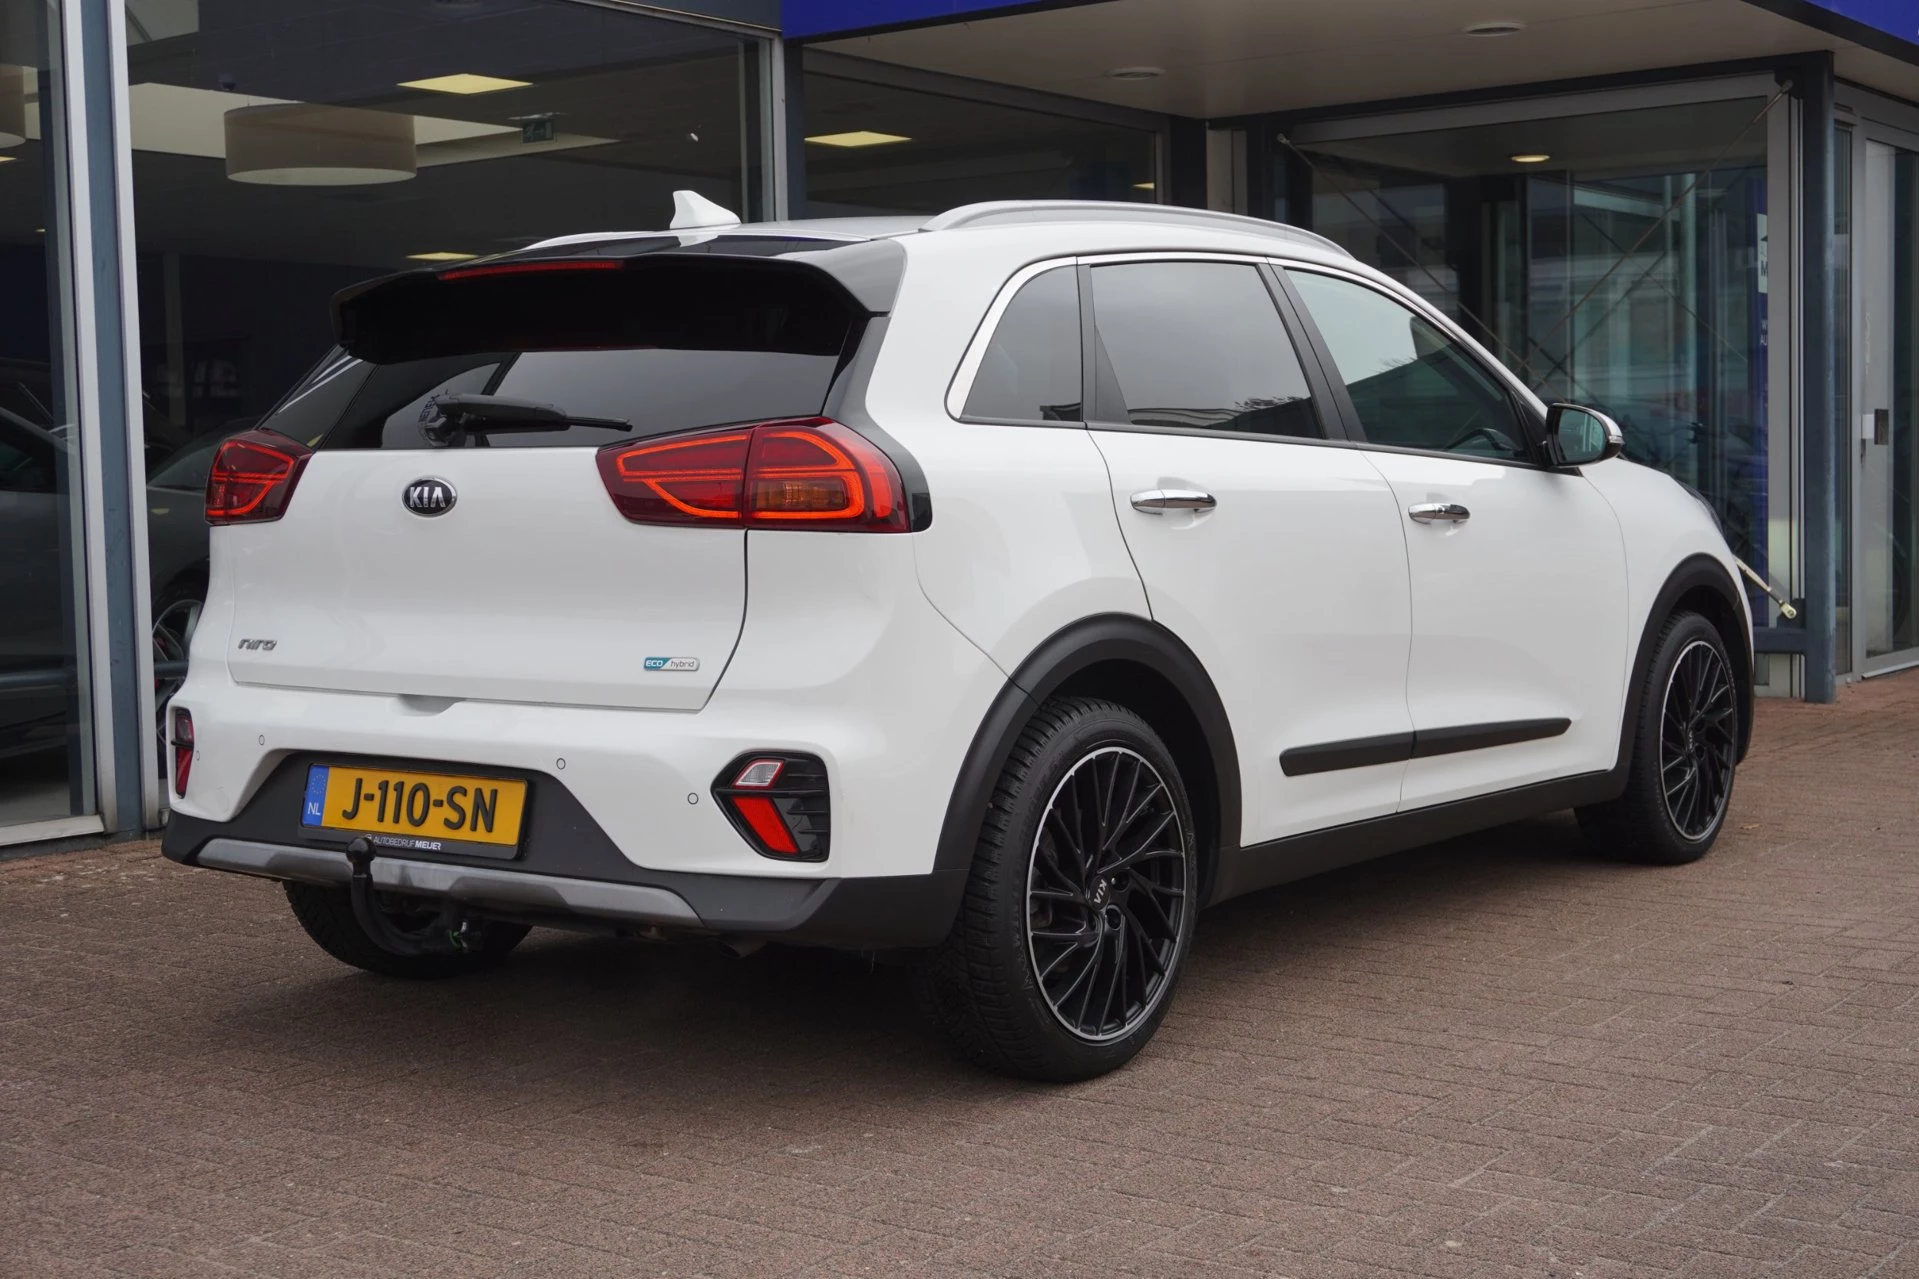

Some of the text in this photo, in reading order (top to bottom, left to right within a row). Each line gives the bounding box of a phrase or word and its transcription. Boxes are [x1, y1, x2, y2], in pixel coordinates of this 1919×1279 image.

[410, 486, 447, 508] KIA
[645, 659, 695, 669] ECO hybrid
[307, 801, 321, 816] NL
[342, 777, 498, 833] J-110-SN
[415, 840, 442, 850] MEIJER
[1093, 879, 1107, 904] KIA
